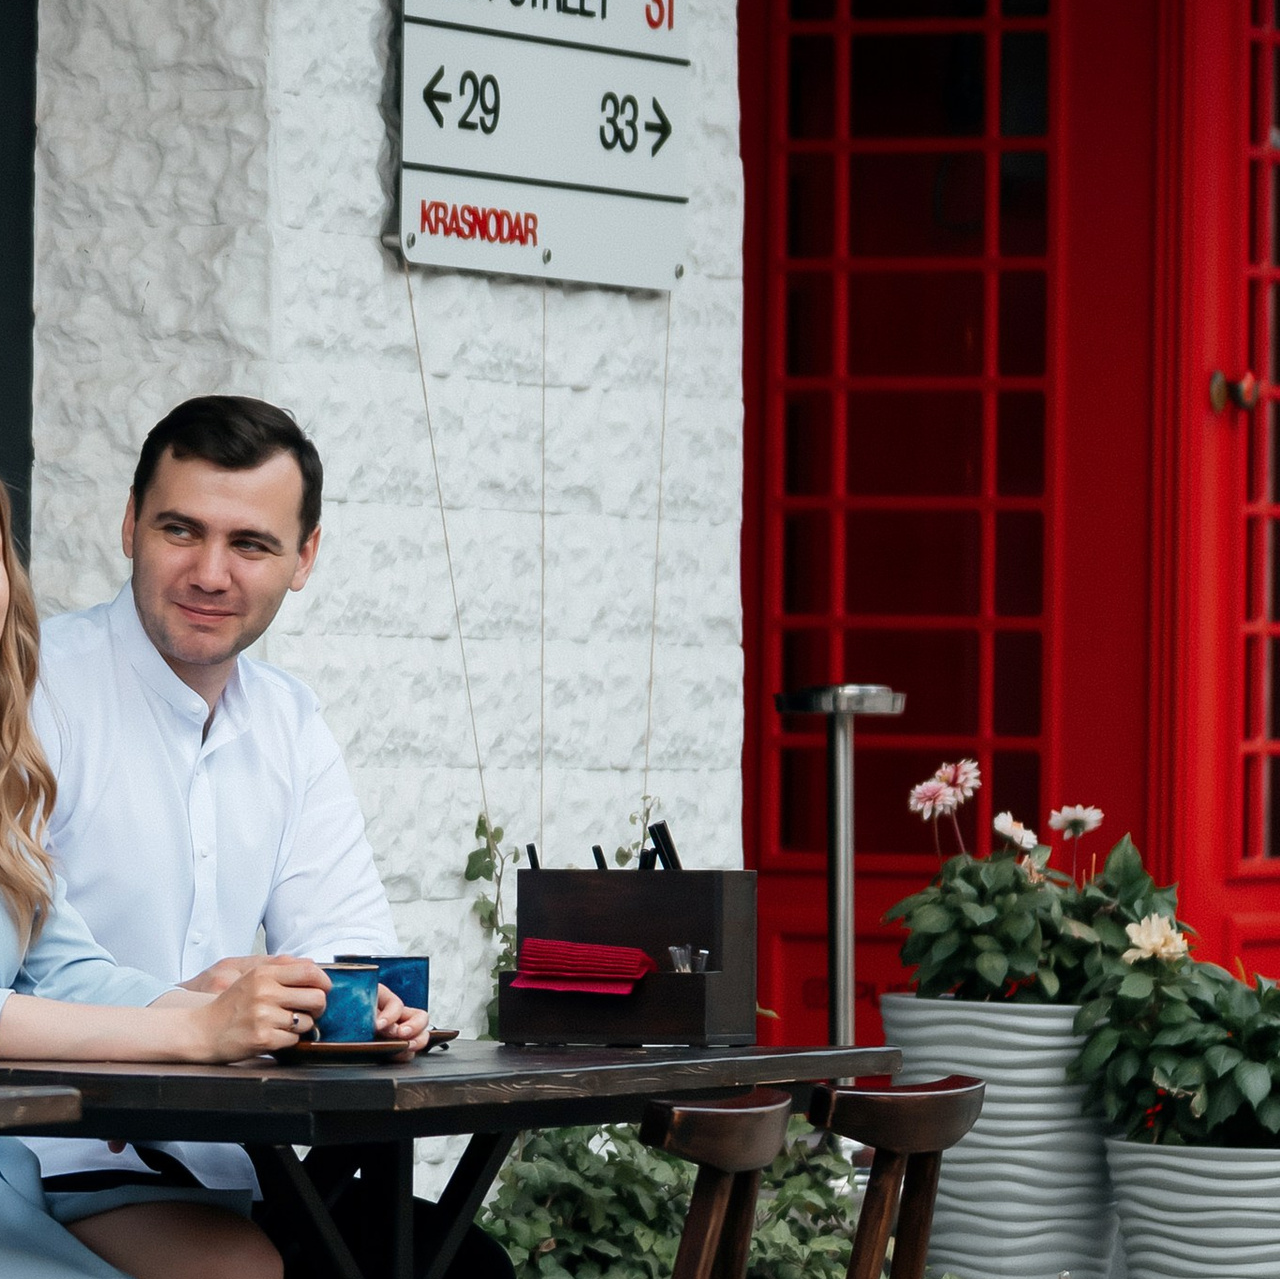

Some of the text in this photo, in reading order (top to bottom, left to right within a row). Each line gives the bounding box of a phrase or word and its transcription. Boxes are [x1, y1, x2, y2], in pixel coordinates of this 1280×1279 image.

[458, 69, 639, 153] 29 33
[420, 199, 539, 247] KRASNODAR
